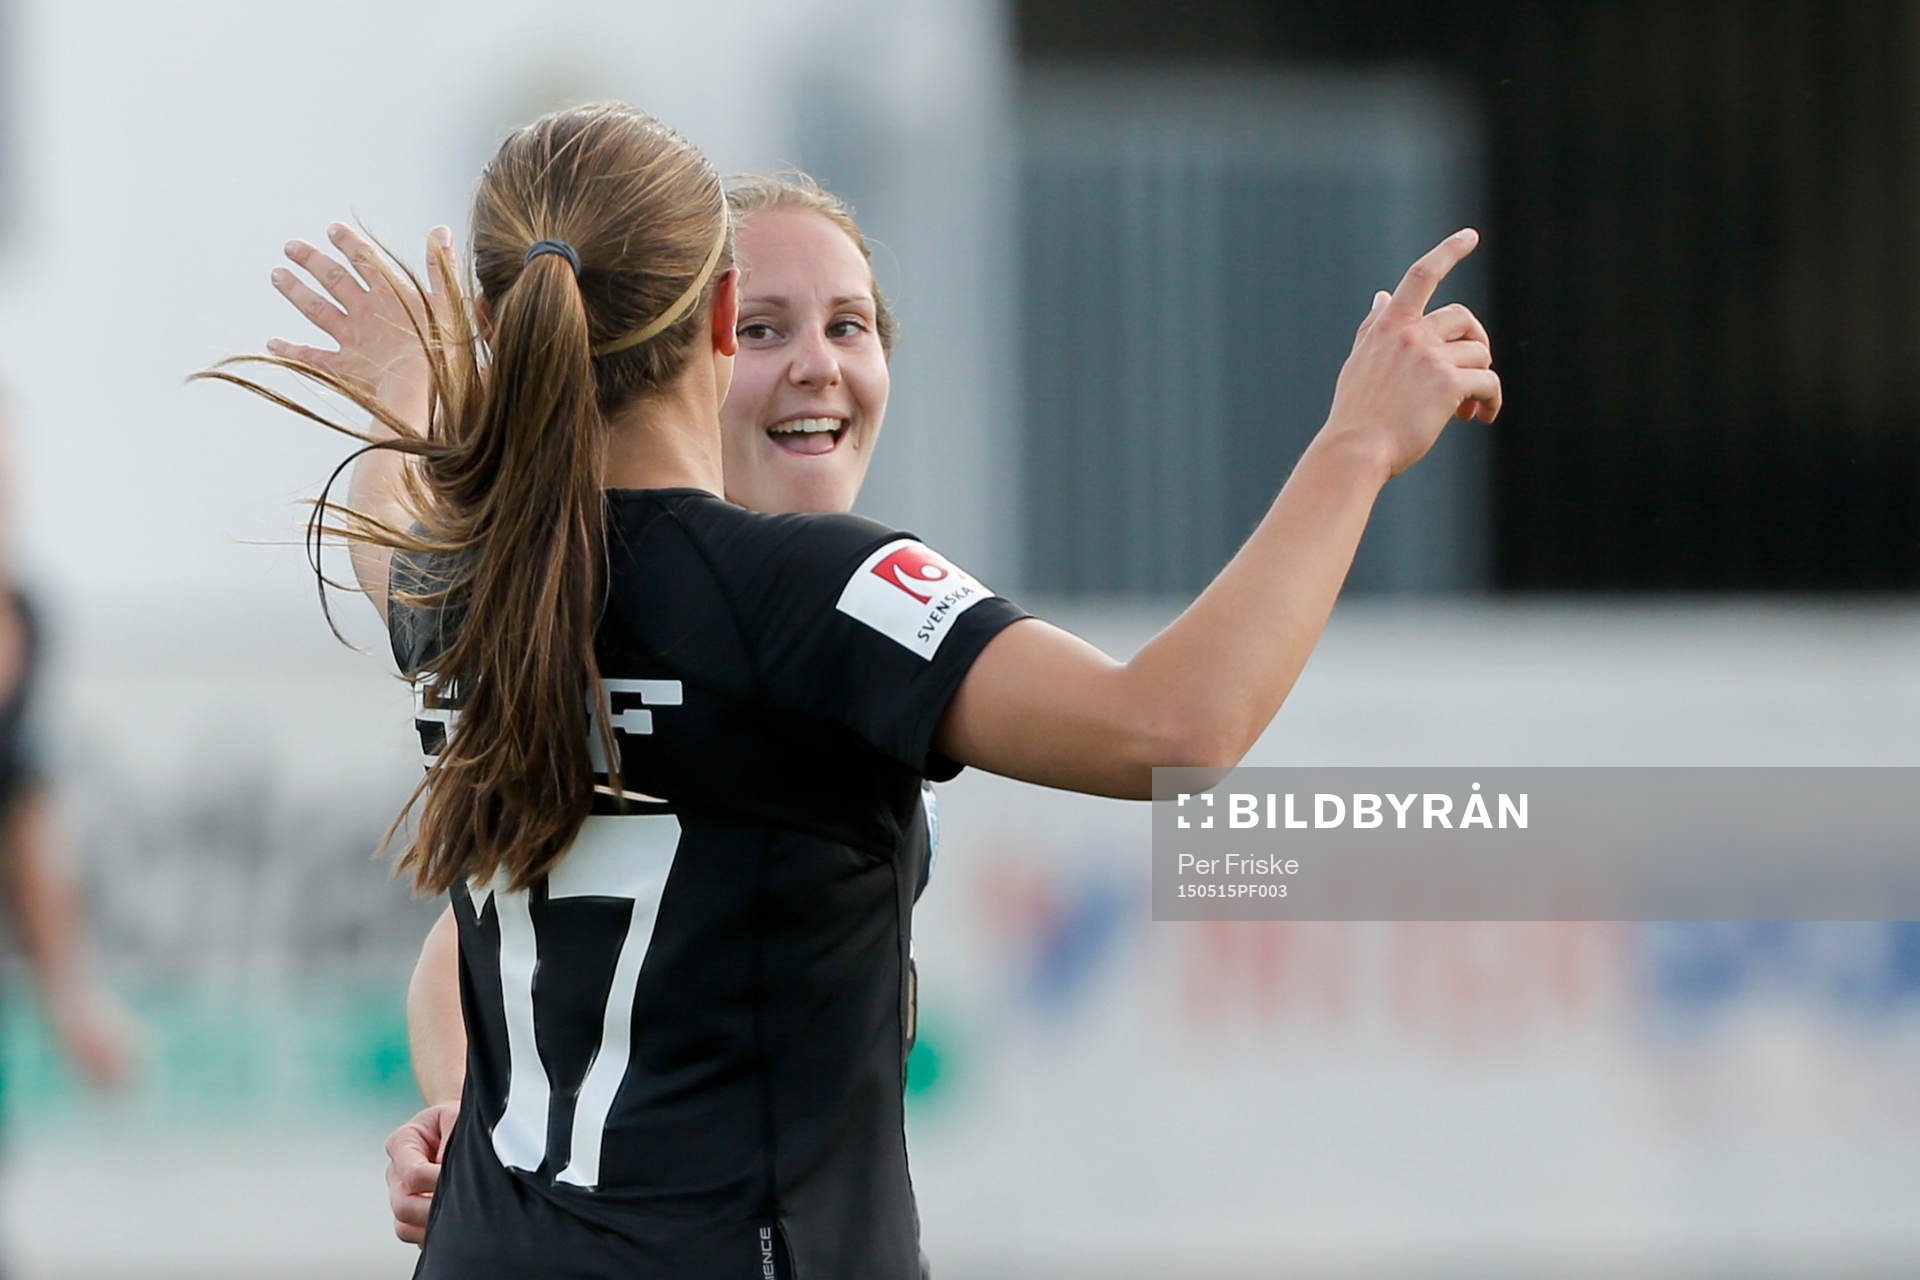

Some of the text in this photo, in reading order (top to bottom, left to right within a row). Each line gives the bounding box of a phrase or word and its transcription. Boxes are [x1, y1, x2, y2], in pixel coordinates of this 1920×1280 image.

[917, 586, 975, 643] SVENSKA
[466, 813, 683, 1187] 17
[759, 1226, 776, 1280] IENCE
